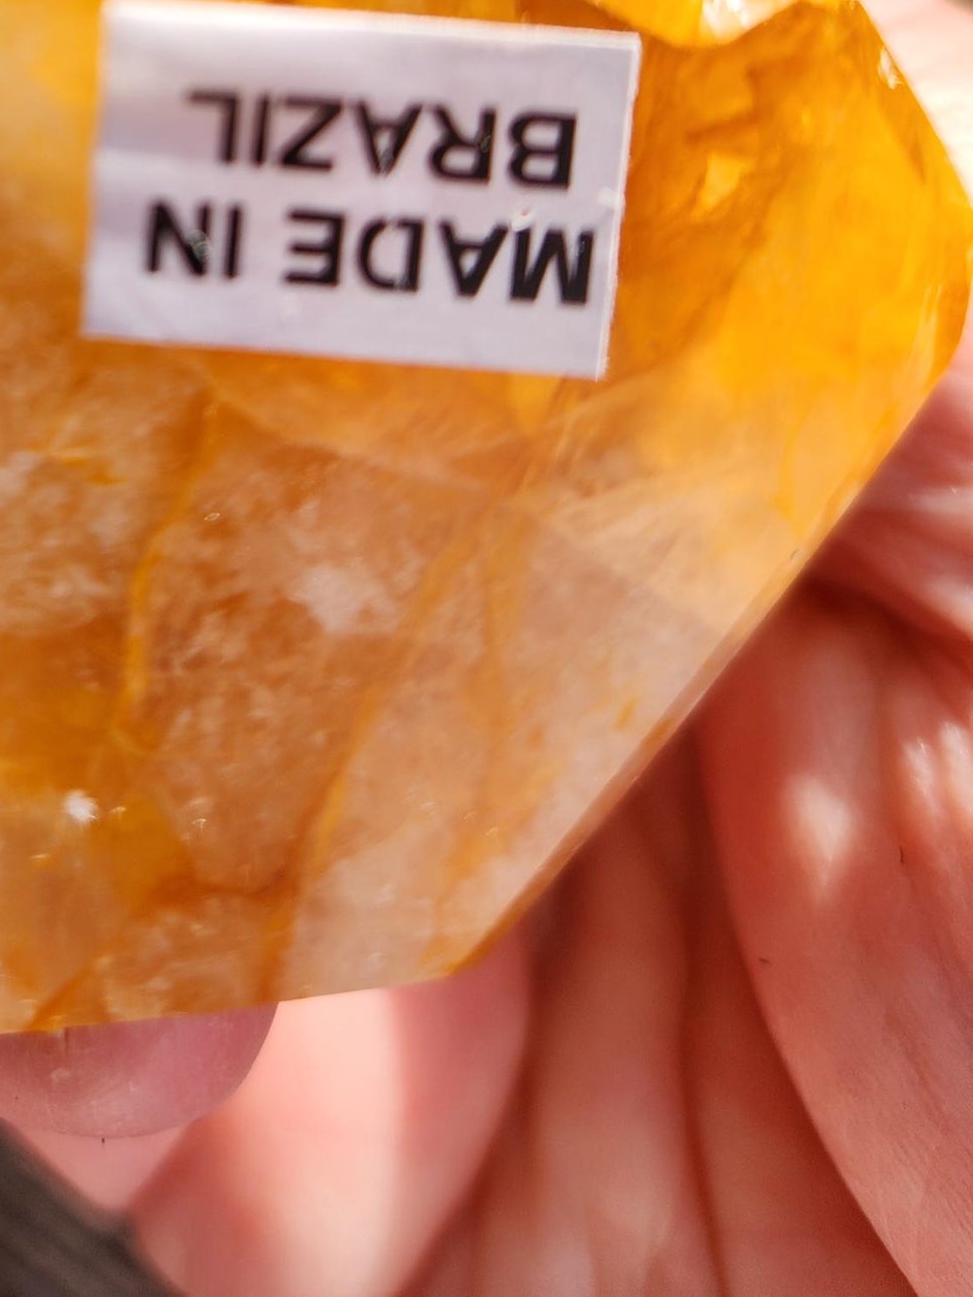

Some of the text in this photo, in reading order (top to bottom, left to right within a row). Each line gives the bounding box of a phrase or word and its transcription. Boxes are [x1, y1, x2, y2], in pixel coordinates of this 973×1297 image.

[187, 90, 578, 192] BRAZIL
[143, 199, 596, 307] MADE IN
